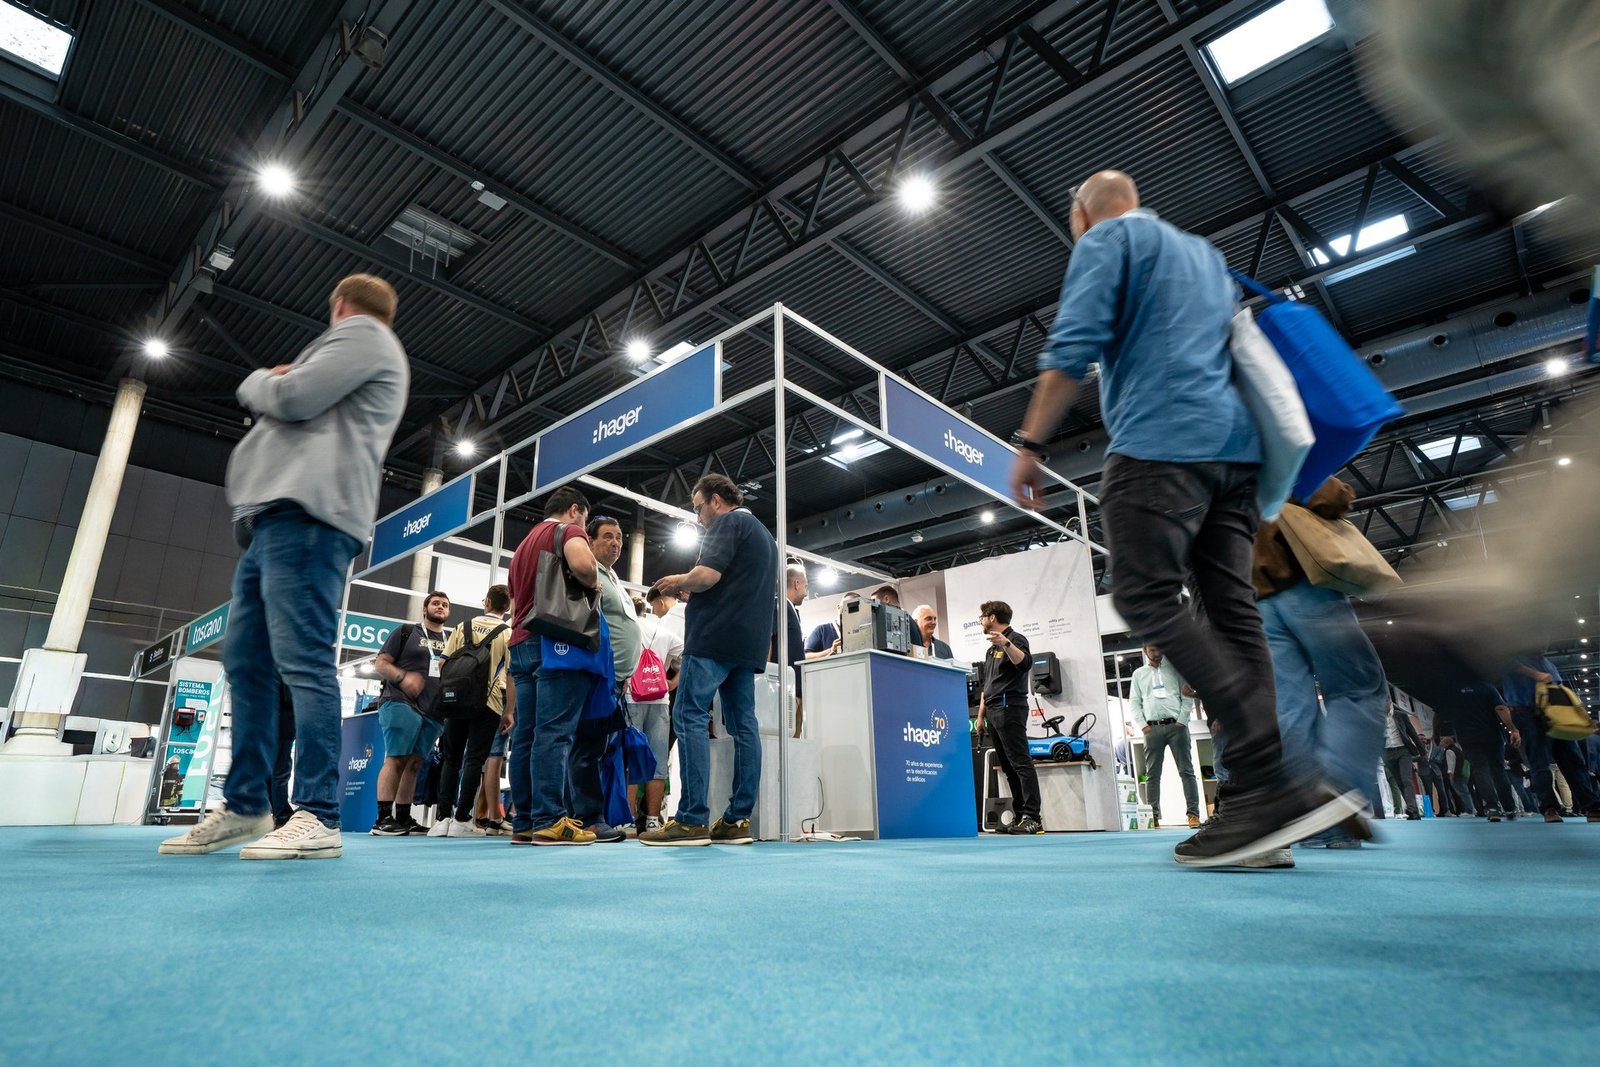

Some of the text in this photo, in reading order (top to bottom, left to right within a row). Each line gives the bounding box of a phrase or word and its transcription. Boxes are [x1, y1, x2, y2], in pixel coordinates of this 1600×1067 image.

[593, 405, 642, 444] :hager
[944, 429, 984, 466] :hager
[403, 512, 432, 538] :hager
[192, 616, 223, 645] toscano
[178, 687, 210, 696] BOMBEROS
[179, 681, 204, 690] SISTEMA
[903, 721, 941, 747] :hager
[934, 717, 945, 730] 70
